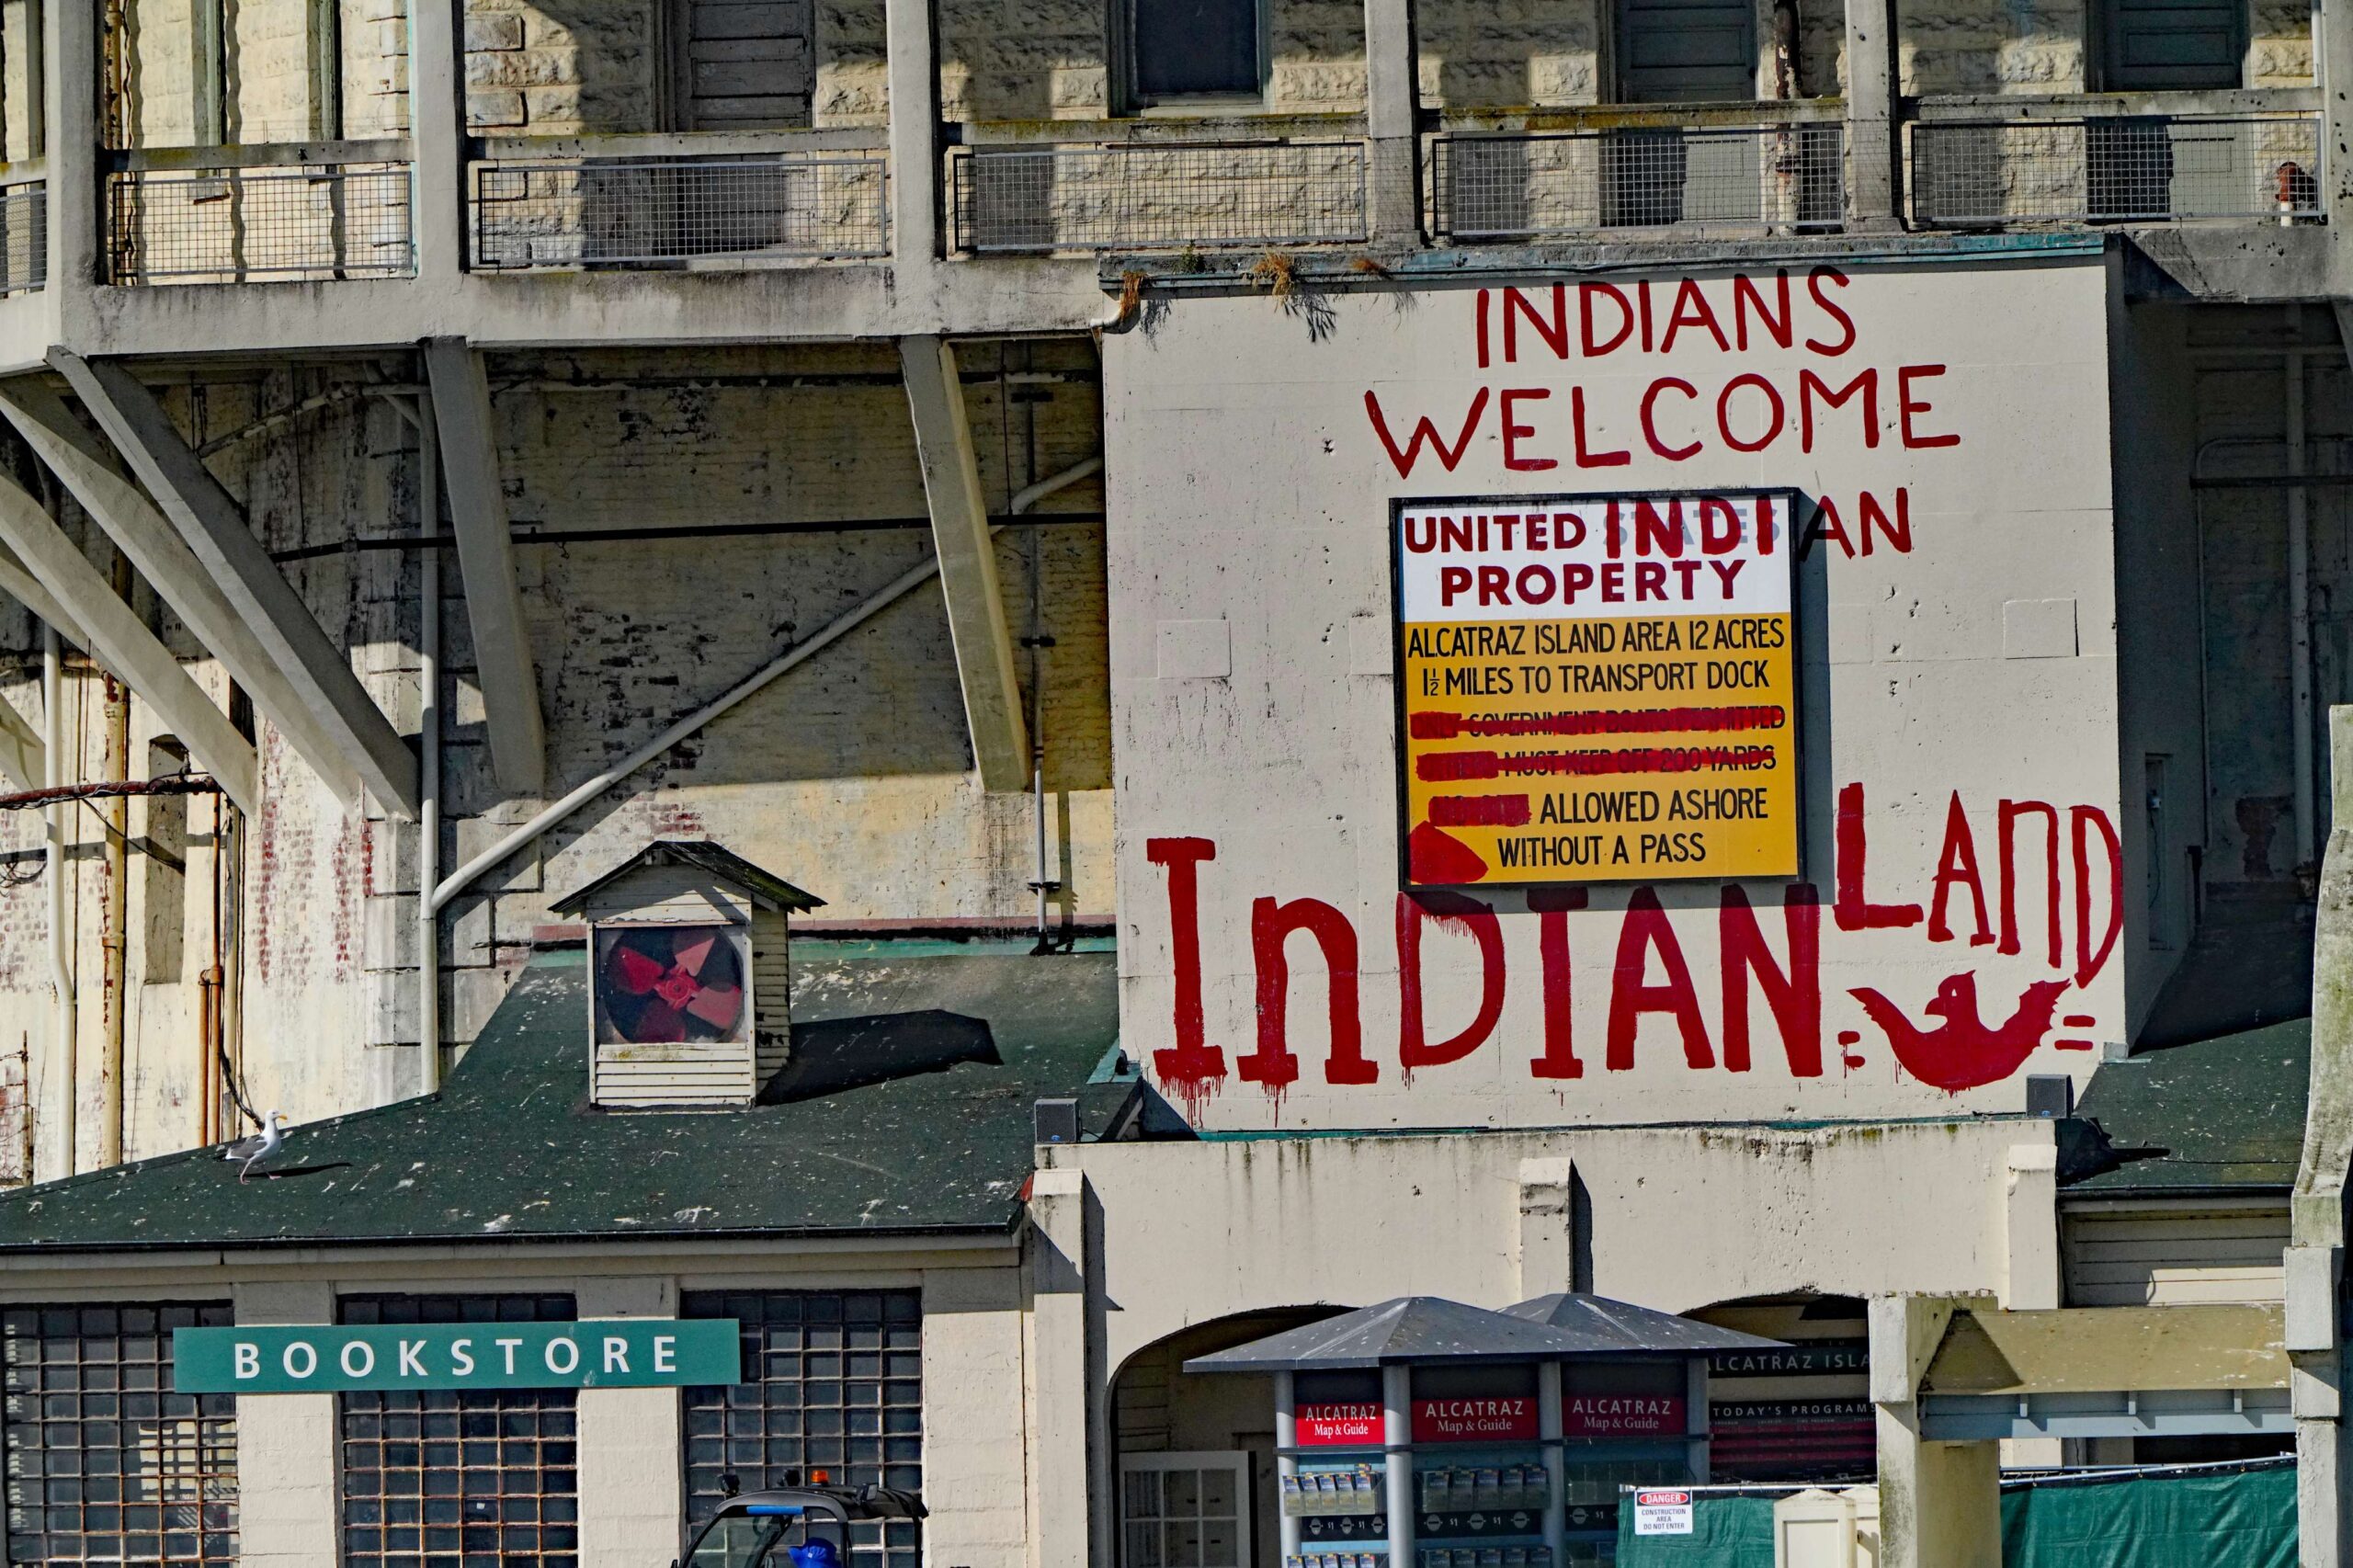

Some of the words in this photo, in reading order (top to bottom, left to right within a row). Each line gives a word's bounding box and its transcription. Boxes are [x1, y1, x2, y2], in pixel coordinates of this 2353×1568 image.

[1477, 265, 1857, 369] INDIANS
[1364, 364, 1961, 480] WELCOME
[1404, 512, 1587, 553] UNITED
[1439, 559, 1747, 608] PROPERTY
[1407, 625, 1526, 659] ALCATRAZ
[1535, 622, 1616, 655] ISLAND
[1621, 621, 1682, 653] AREA
[1688, 620, 1710, 652] 12
[1712, 618, 1786, 650] ACRES
[1445, 665, 1514, 697] MILES
[1518, 665, 1552, 695] TO
[1552, 662, 1699, 694] TRANSPORT
[1706, 659, 1770, 690] DOCK
[1705, 744, 1777, 772] YARDS
[1539, 790, 1660, 824] ALLOWED
[1667, 787, 1768, 821] ASHORE
[1497, 835, 1603, 868] WITHOUT
[1611, 835, 1631, 865] A
[1641, 832, 1707, 864] PASS
[234, 1335, 676, 1379] BOOKSTORE
[1305, 1404, 1377, 1422] ALCATRAZ
[1426, 1400, 1523, 1418] ALCATRAZ
[1573, 1399, 1672, 1415] ALCATRAZ
[1712, 1405, 1782, 1417] TODAY'S
[1314, 1424, 1334, 1439] Map
[1335, 1424, 1342, 1436] &
[1343, 1423, 1370, 1437] Guide
[1437, 1419, 1463, 1435] Map
[1465, 1418, 1475, 1432] &
[1477, 1416, 1513, 1431] Guide
[1584, 1416, 1610, 1432] Map
[1612, 1416, 1622, 1429] &
[1624, 1416, 1660, 1430] Guide
[1646, 1494, 1681, 1504] DANGER
